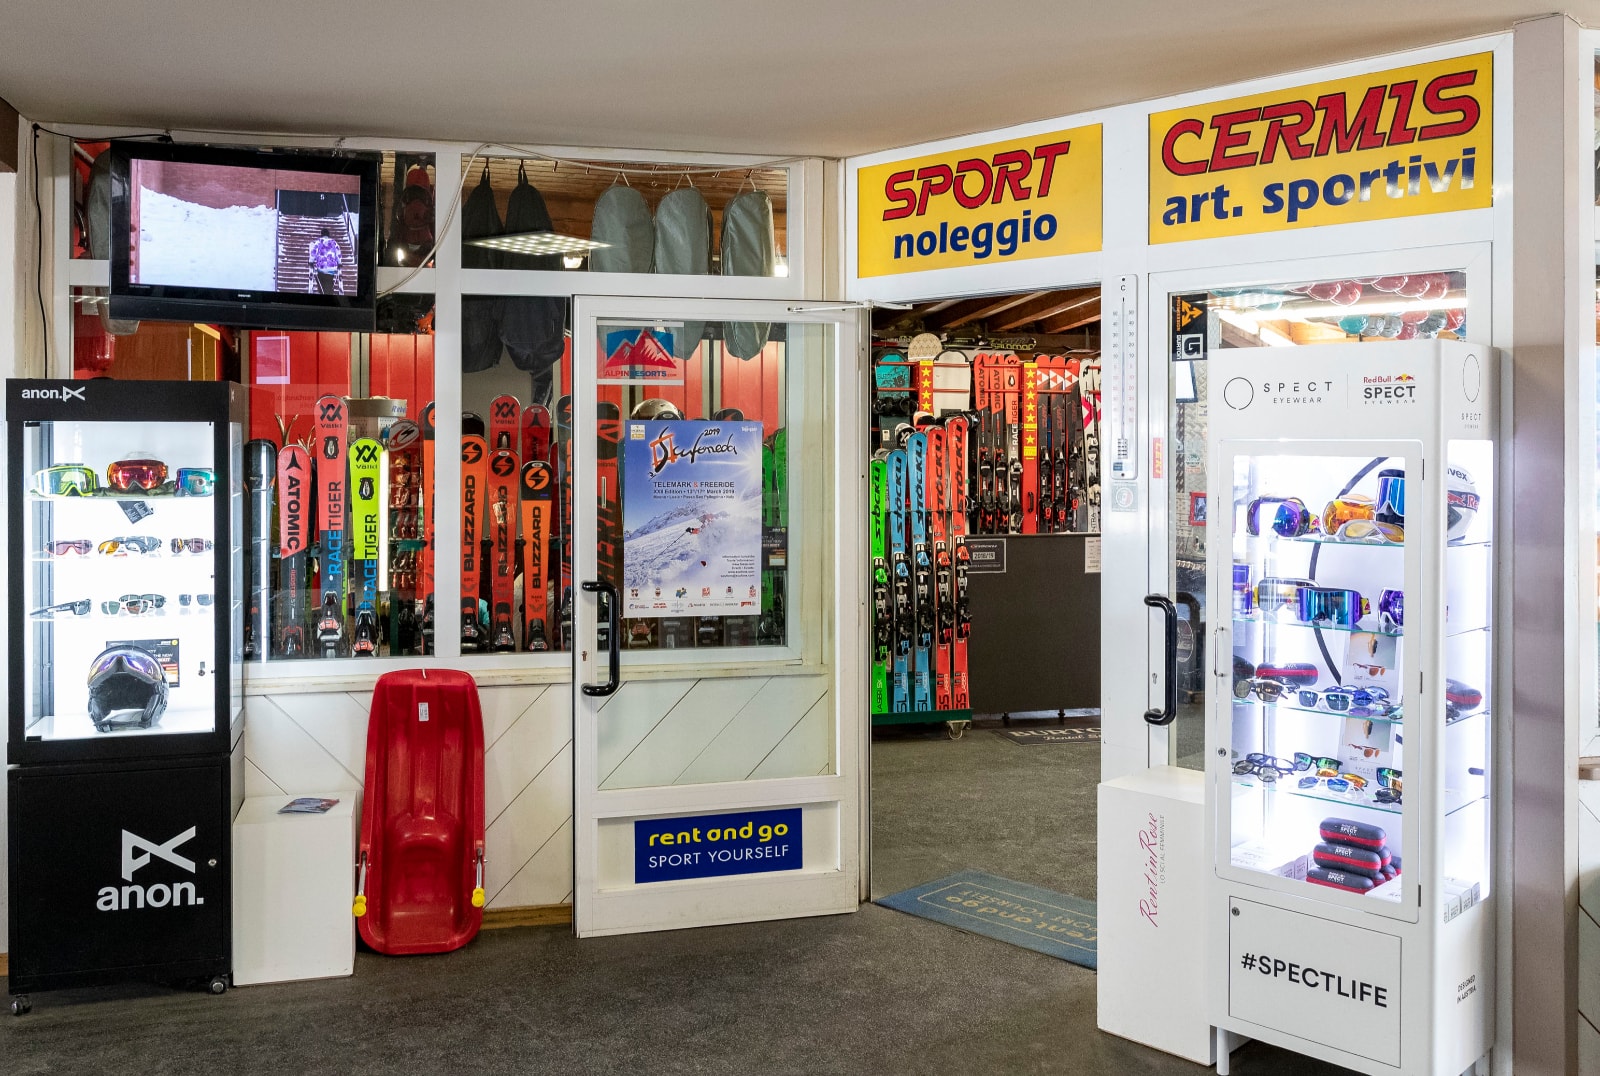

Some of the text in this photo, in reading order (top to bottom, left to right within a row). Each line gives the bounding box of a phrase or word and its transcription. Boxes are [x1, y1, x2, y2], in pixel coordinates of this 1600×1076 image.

[1162, 69, 1481, 177] CERMIS
[882, 140, 1070, 221] SPORT
[1162, 146, 1477, 226] art. sportivi
[893, 209, 1058, 260] noleggio
[22, 388, 62, 399] anon.
[978, 370, 986, 406] ATOMIC
[1264, 381, 1333, 393] SPECT
[1363, 374, 1392, 384] Red Bull
[1363, 385, 1416, 400] SPECT
[704, 428, 720, 436] 2019
[1462, 412, 1482, 421] SPECT
[287, 475, 300, 551] ATOMIC
[464, 475, 476, 572] BLIZZARD
[498, 486, 508, 577] BLIZZARD
[532, 506, 542, 588] BLIZZARD
[649, 821, 788, 846] rent and go
[648, 844, 789, 868] SPORT YOURSELF
[1139, 812, 1158, 928] Rent in Rose
[96, 882, 204, 911] anon.
[1241, 952, 1387, 1008] #SPECTLIFE
